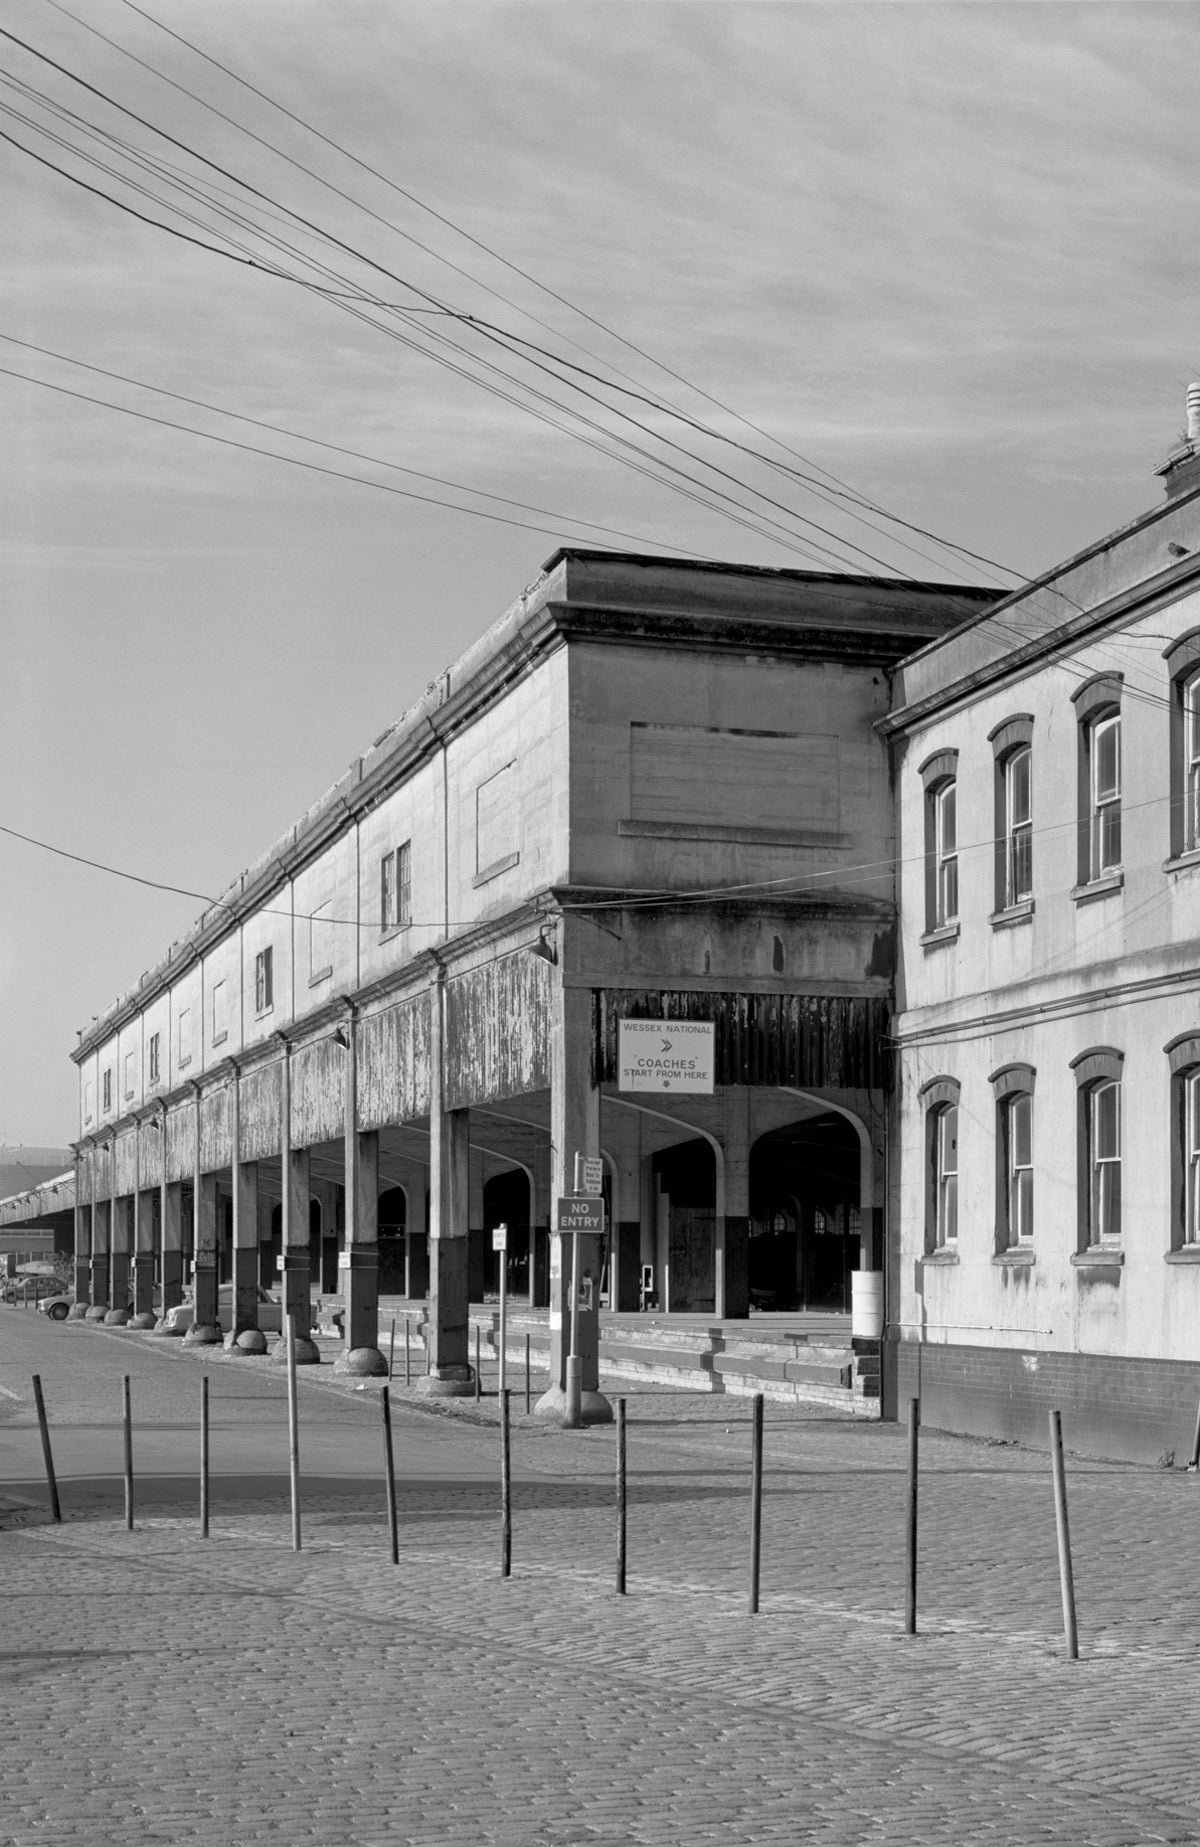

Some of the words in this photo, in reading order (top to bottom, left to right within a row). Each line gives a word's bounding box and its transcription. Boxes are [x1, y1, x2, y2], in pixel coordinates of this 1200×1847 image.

[623, 1023, 663, 1033] WESSEX
[666, 1025, 712, 1035] NATIONAL
[637, 1058, 696, 1070] COACHES
[623, 1068, 653, 1078] START
[656, 1070, 682, 1079] FROM
[684, 1072, 709, 1080] HERE
[571, 1203, 590, 1214] NO
[561, 1216, 600, 1227] ENTRY
